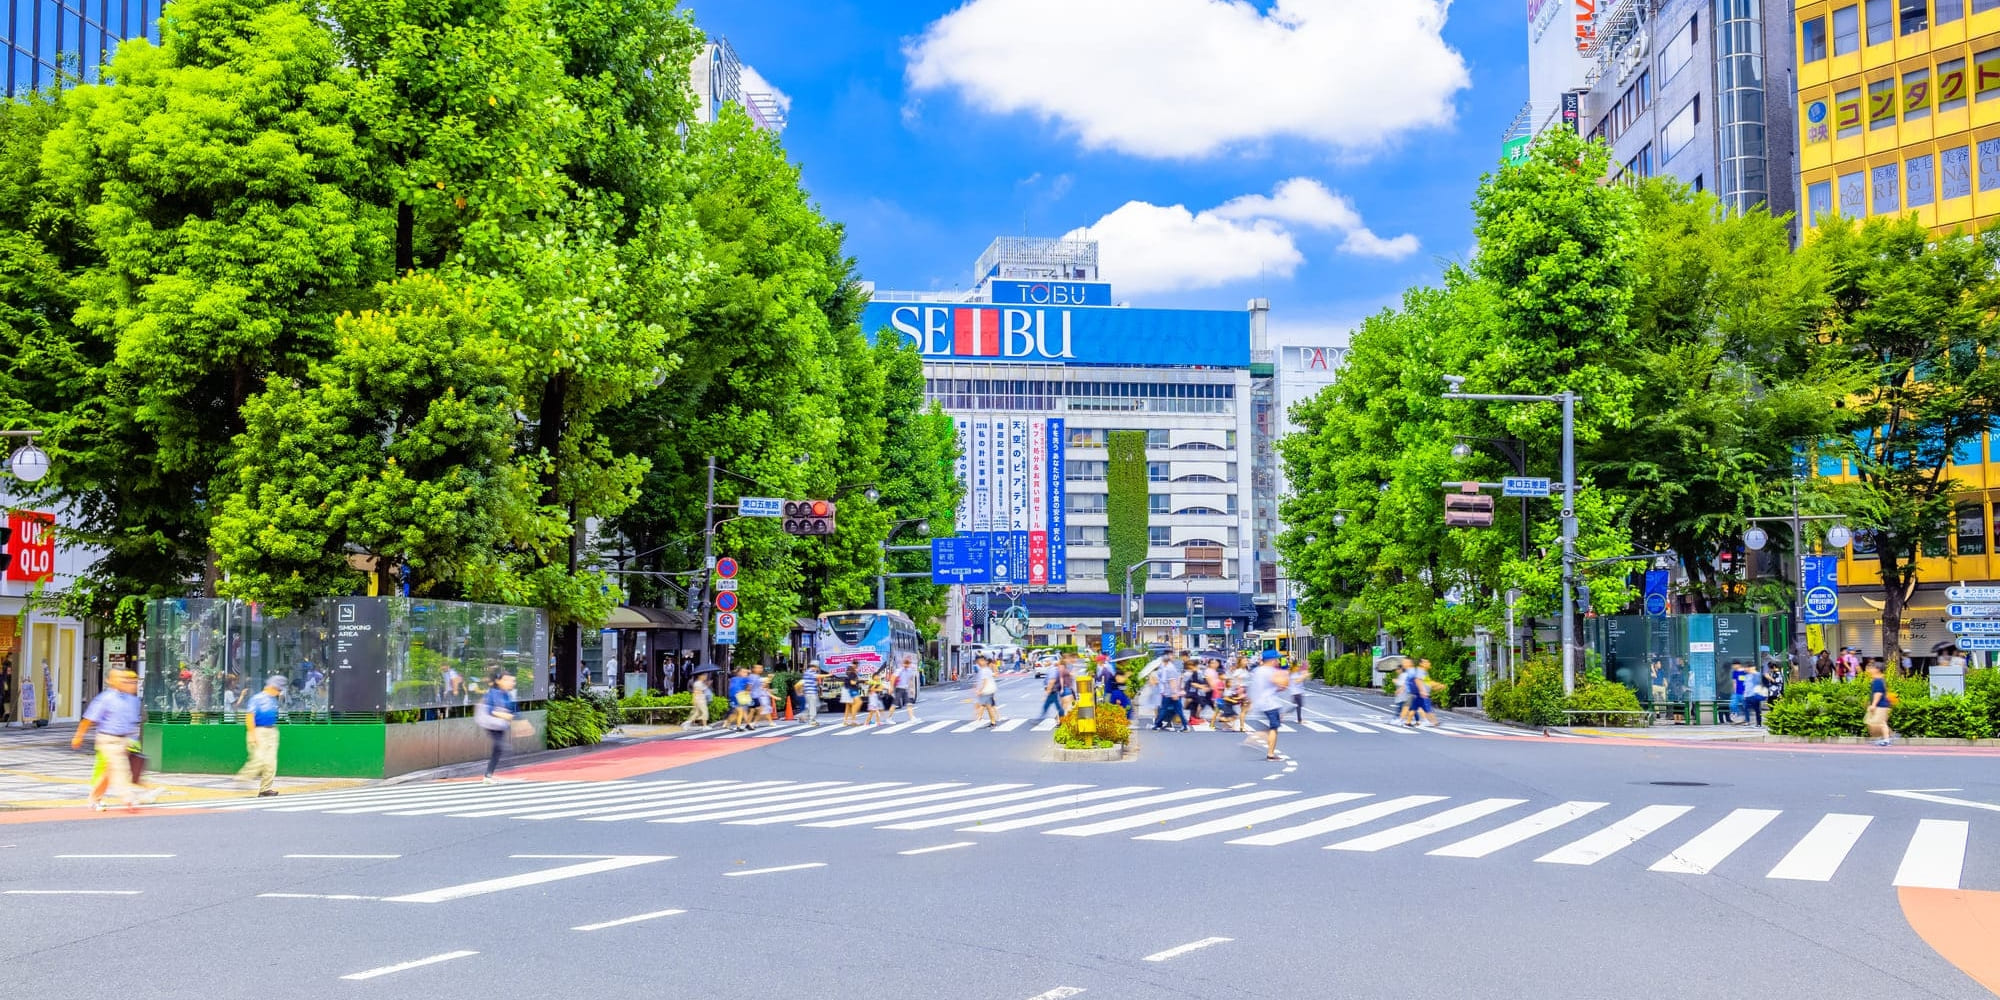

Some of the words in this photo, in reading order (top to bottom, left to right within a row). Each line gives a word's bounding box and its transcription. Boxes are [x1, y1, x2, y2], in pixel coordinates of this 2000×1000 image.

[1839, 64, 2000, 126] コンタクト
[1808, 124, 1829, 142] 中央
[1017, 283, 1086, 305] TOBU
[891, 306, 1077, 359] SEIBU
[21, 548, 49, 576] QLO
